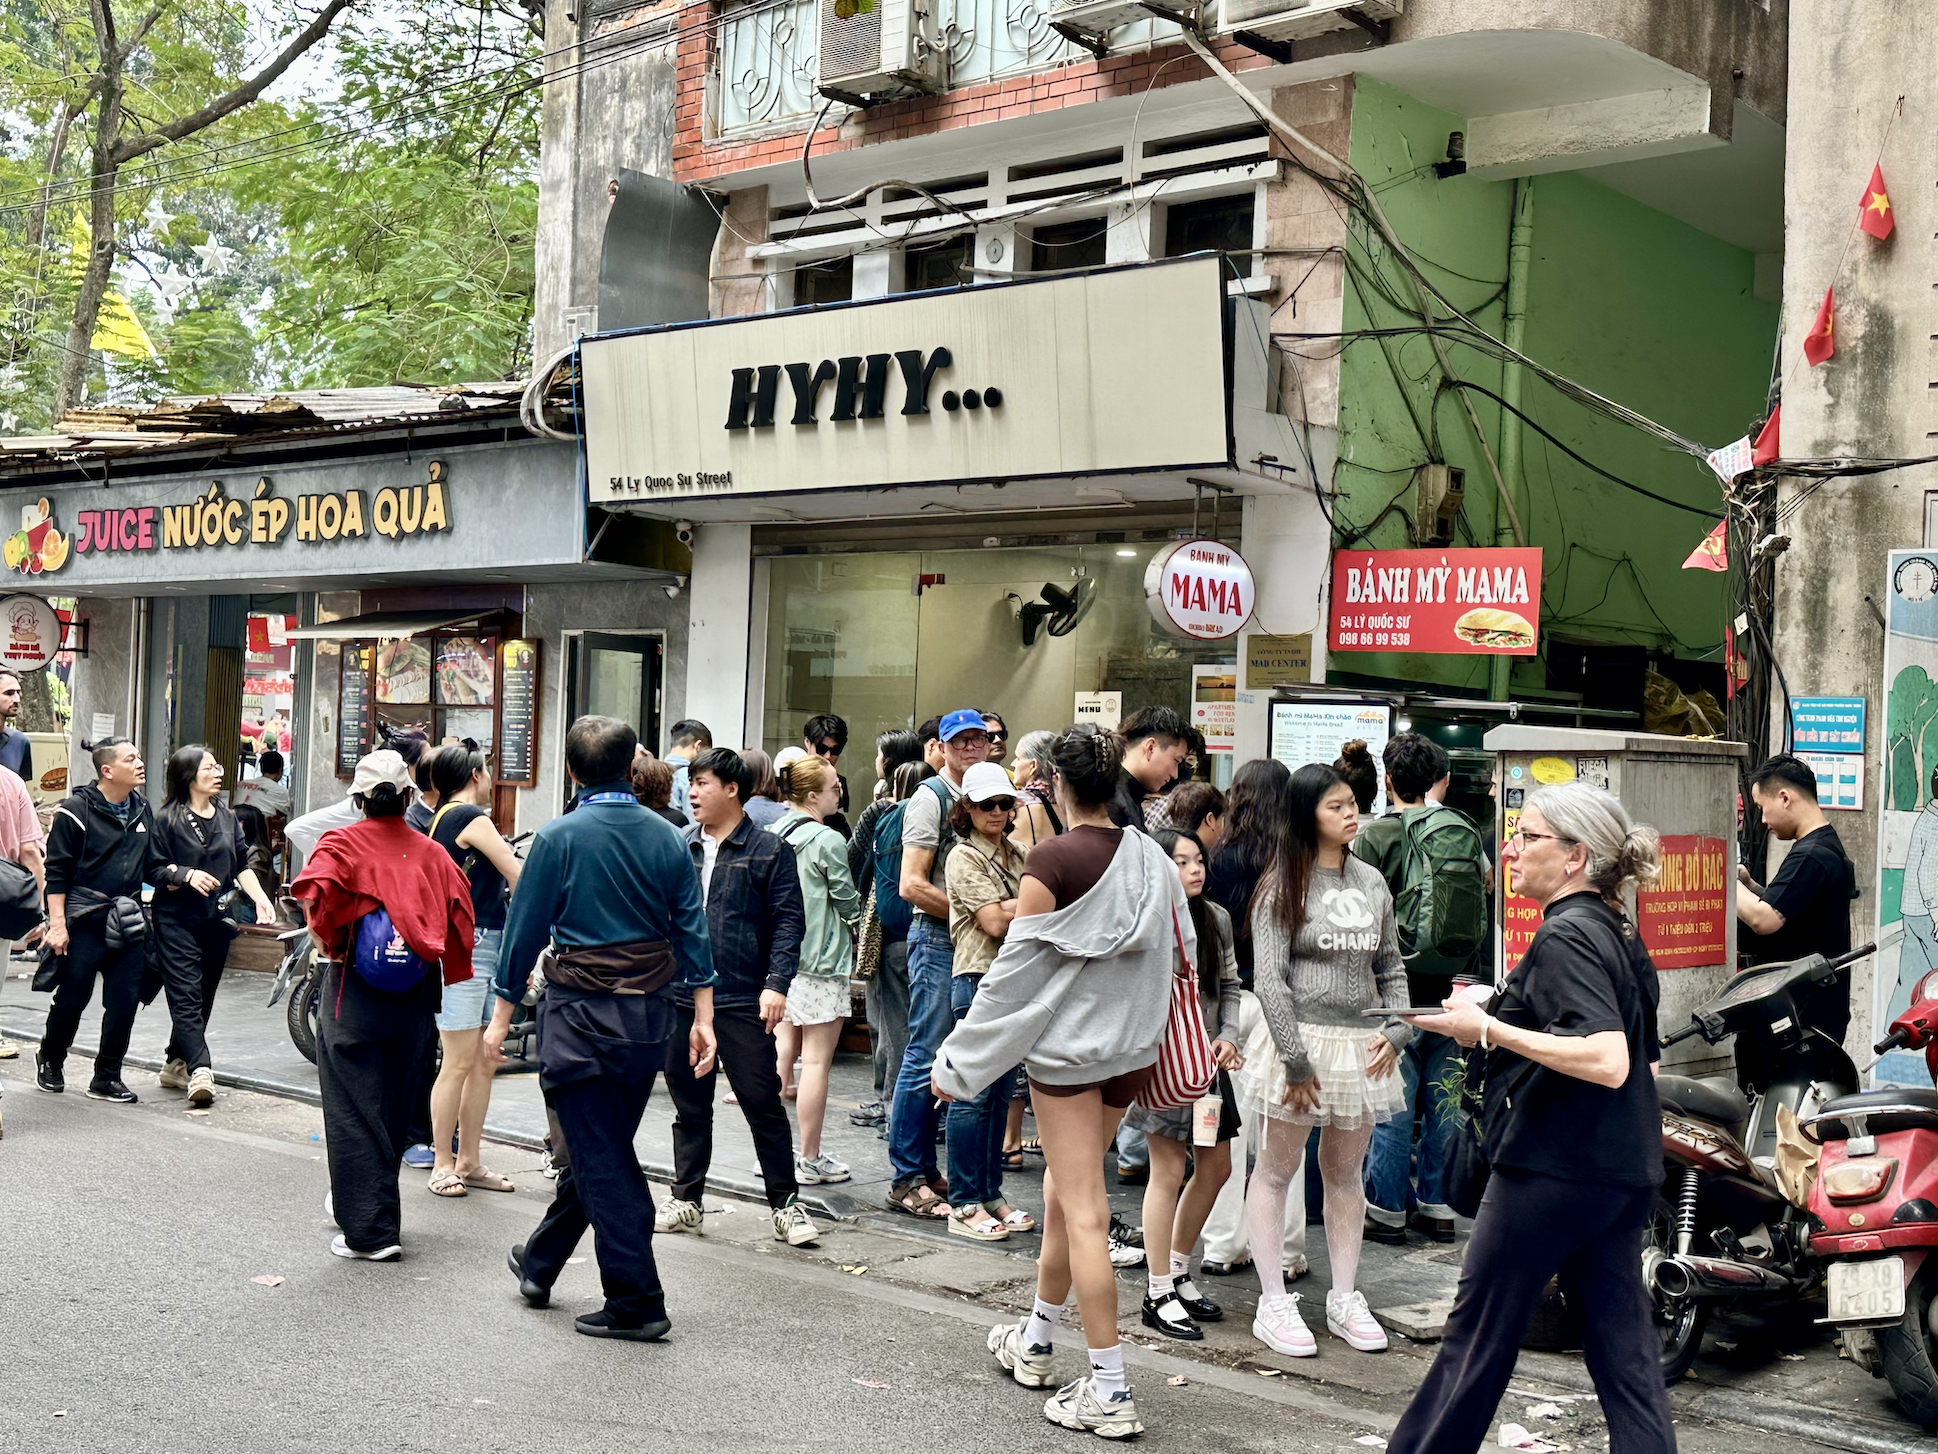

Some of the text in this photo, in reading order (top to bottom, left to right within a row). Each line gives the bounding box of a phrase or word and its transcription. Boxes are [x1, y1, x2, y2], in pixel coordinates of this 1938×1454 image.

[725, 346, 1003, 430] HYHY...
[610, 471, 732, 492] 54 Ly Quoc Su Street
[76, 461, 448, 553] JUICE NƯỚC ÉP HOA QUẢ
[1190, 548, 1215, 565] BÁNH
[1345, 556, 1530, 604] BÁNH MỲ MAMA
[1170, 572, 1243, 617] MAMA
[1339, 611, 1412, 629] 54 LÝ QUỐC SƯ
[1339, 632, 1411, 646] 098 66 99 538
[1271, 659, 1307, 668] CENTER
[1356, 717, 1384, 725] mama
[1644, 845, 1683, 893] ÔNG
[1702, 845, 1724, 891] RÁC
[1517, 907, 1538, 922] HỢP
